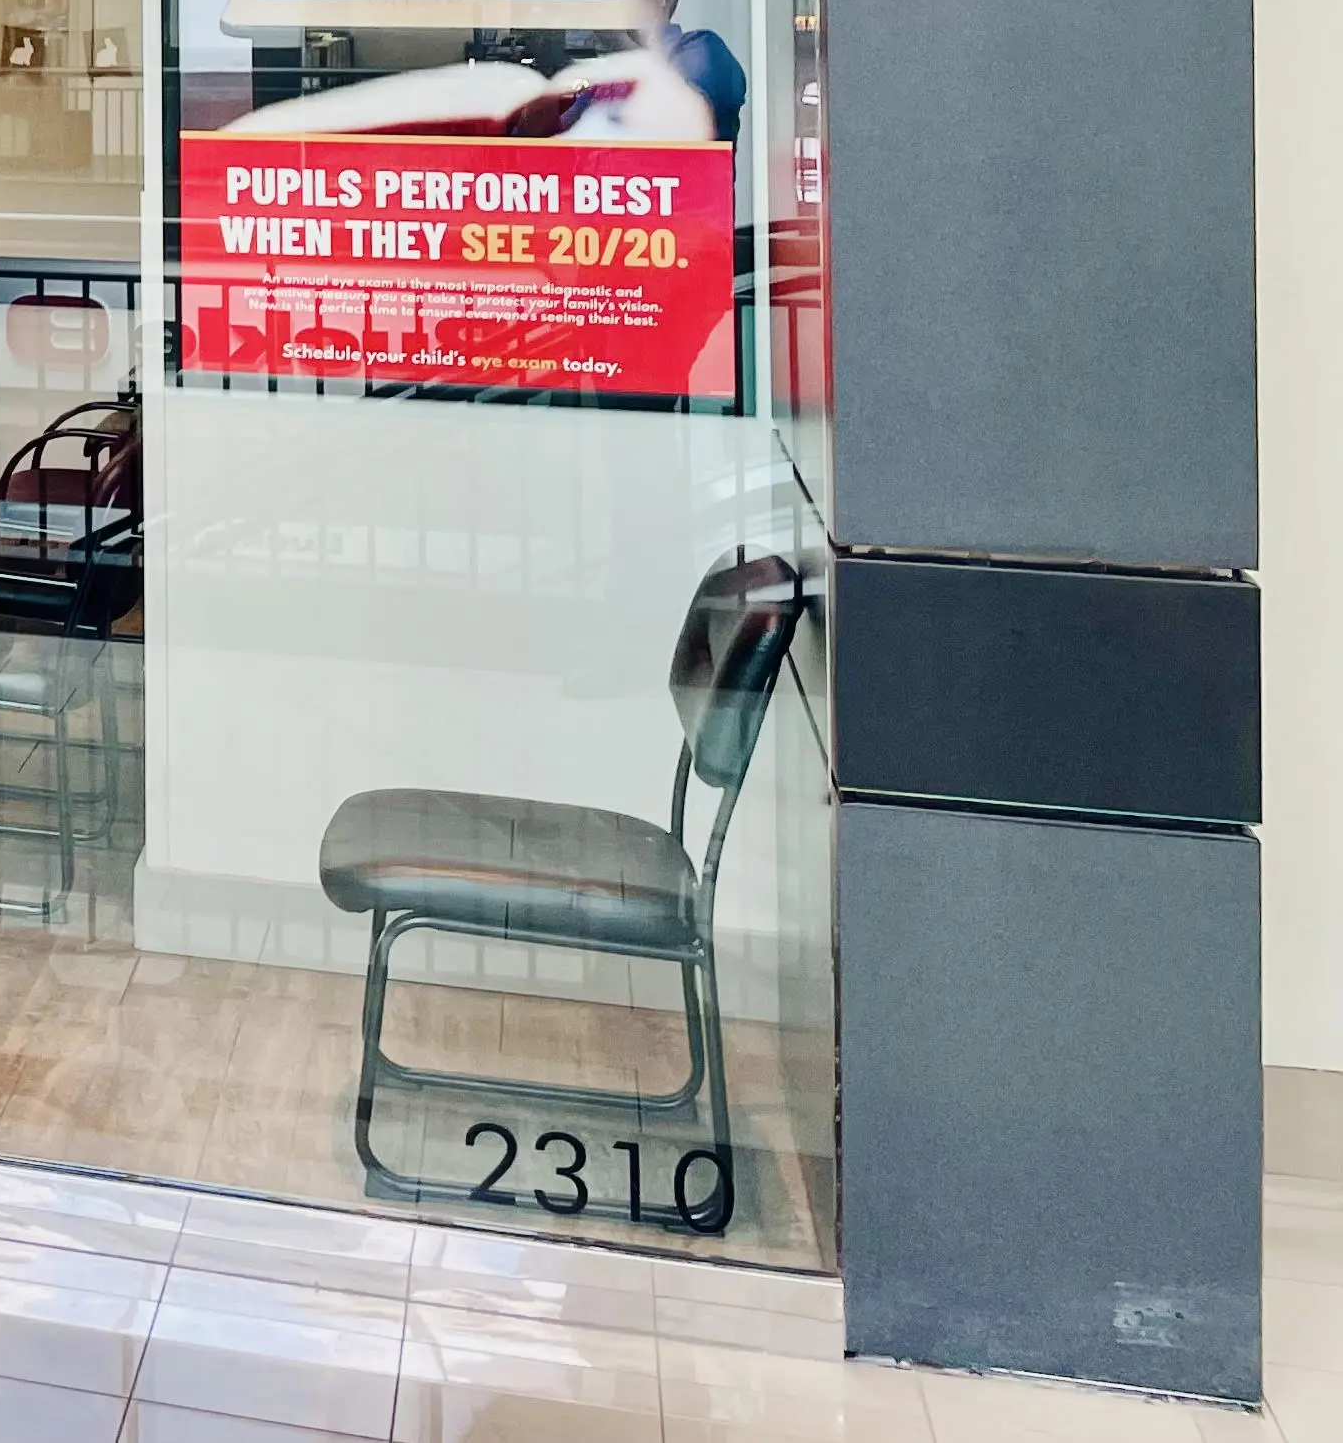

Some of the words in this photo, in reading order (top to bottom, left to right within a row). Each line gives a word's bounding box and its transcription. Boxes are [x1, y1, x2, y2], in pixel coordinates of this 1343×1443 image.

[225, 166, 363, 208] PUPILS
[375, 170, 560, 214] PERFORM
[573, 175, 681, 217] BEST
[219, 215, 333, 257] WHEN
[345, 219, 448, 261] THEY
[461, 222, 536, 263] SEE
[548, 225, 689, 269] 20/20.
[262, 272, 280, 285] An
[283, 274, 329, 286] annual
[331, 277, 355, 289] eye
[357, 278, 394, 289] exam
[397, 277, 408, 289] is
[410, 277, 433, 290] the
[435, 278, 467, 291] most
[470, 280, 539, 296] important
[541, 283, 612, 300] diagnostic
[615, 285, 643, 297] and
[315, 289, 370, 301] measure
[373, 293, 402, 305] you
[406, 293, 424, 303] can
[427, 292, 457, 304] take
[460, 294, 474, 305] to
[477, 295, 526, 309] protect
[528, 298, 561, 312] your
[618, 300, 664, 313] vision.
[248, 298, 278, 310] Now
[295, 301, 315, 312] the
[319, 302, 366, 315] perfect
[368, 304, 398, 316] time
[401, 305, 414, 316] to
[418, 307, 463, 318] ensure
[541, 311, 585, 327] seeing
[588, 312, 621, 325] their
[624, 313, 659, 327] best.
[282, 343, 361, 362] Schedule
[366, 350, 407, 366] your
[471, 356, 502, 372] eye
[508, 356, 557, 371] exam
[562, 357, 623, 377] today.
[464, 1122, 736, 1234] 2310
